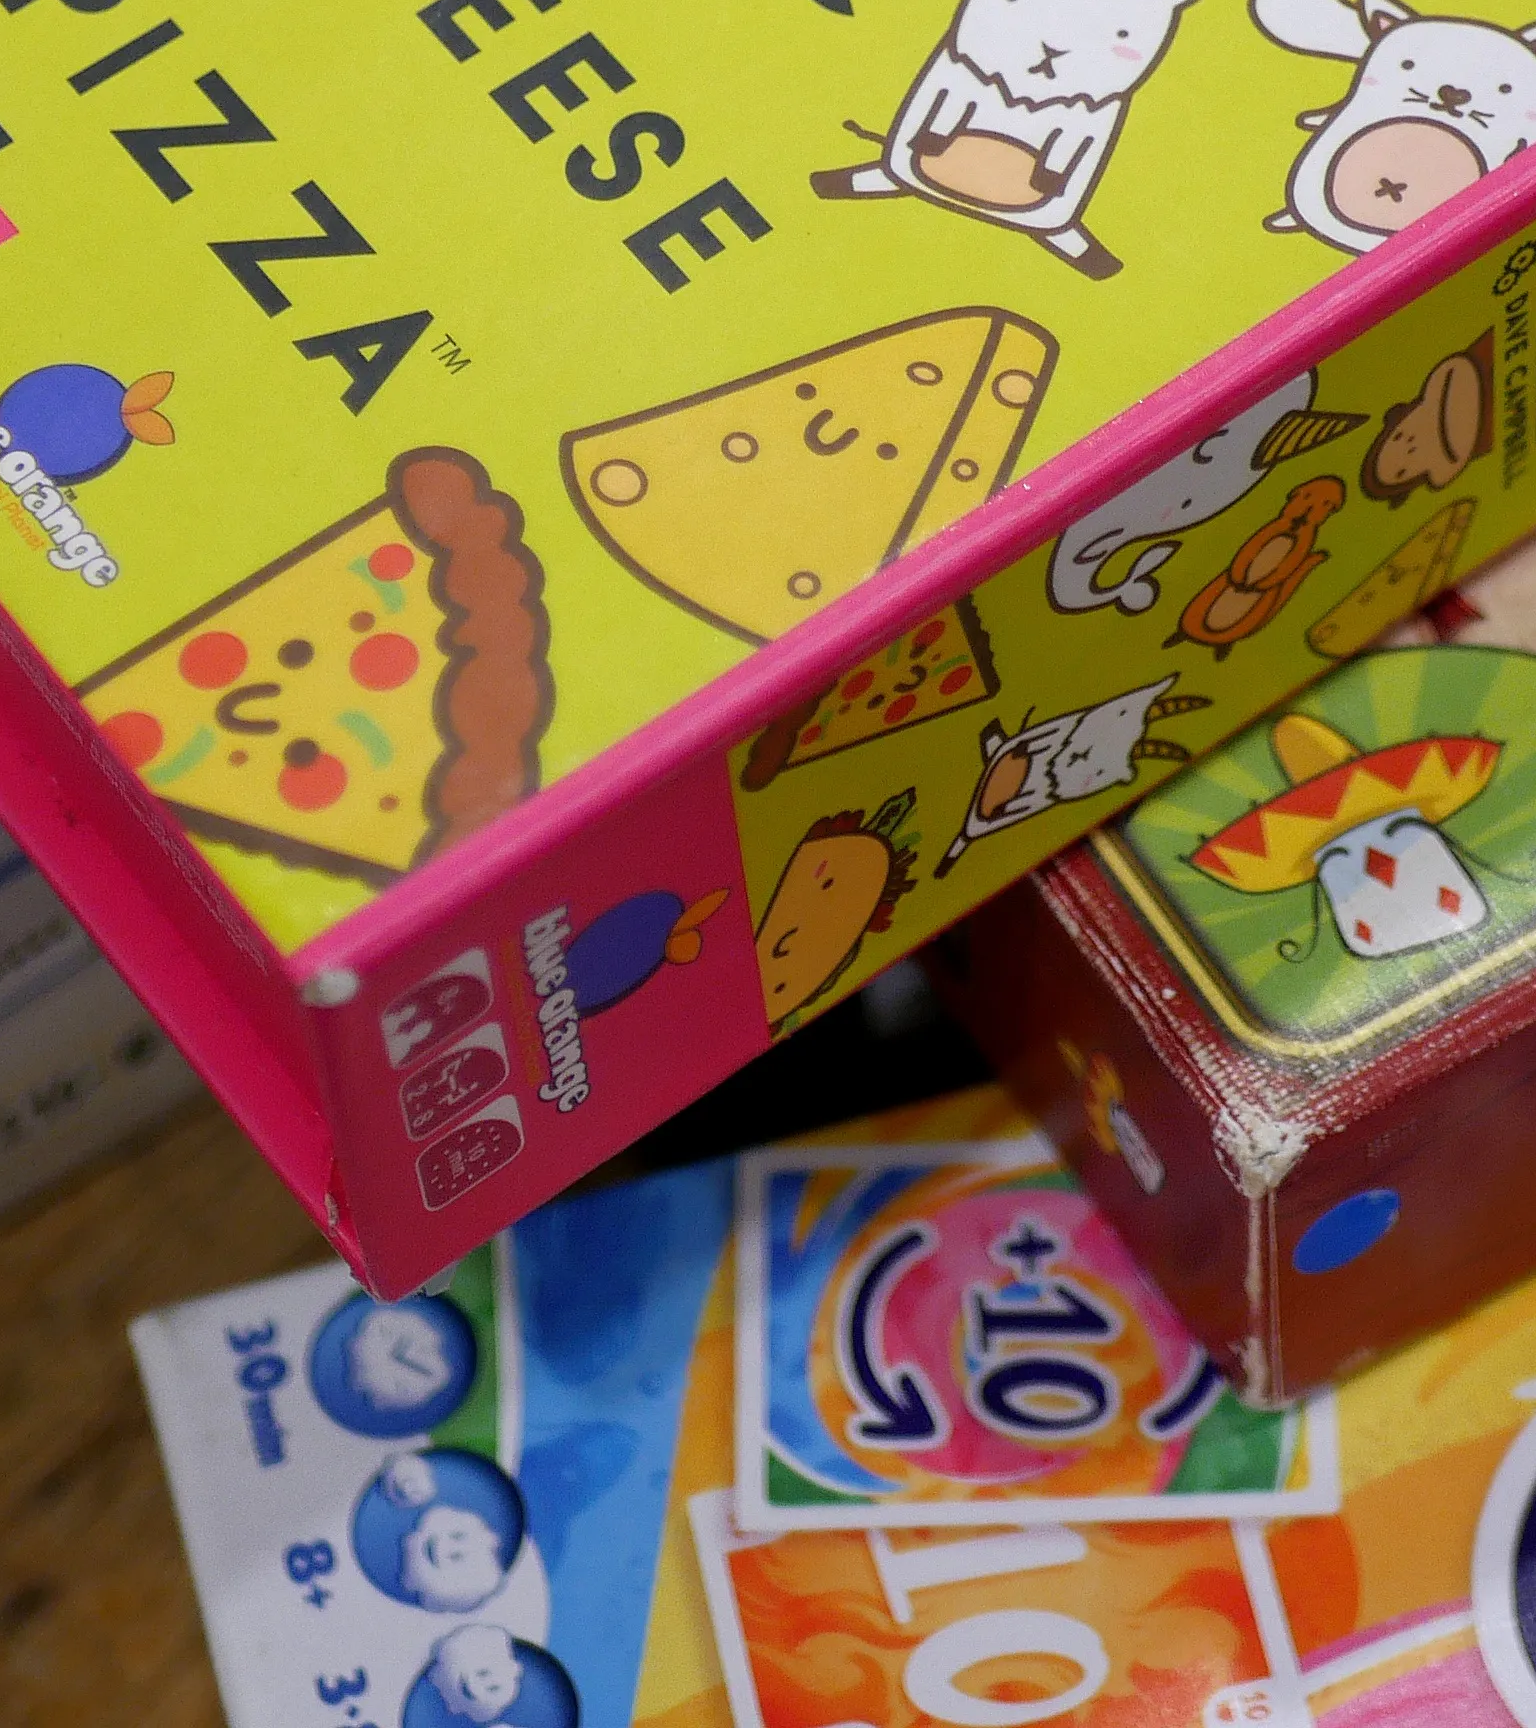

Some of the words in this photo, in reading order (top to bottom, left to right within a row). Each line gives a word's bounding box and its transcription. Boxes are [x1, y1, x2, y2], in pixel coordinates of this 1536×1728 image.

[1504, 290, 1531, 364] DAVE
[1503, 365, 1531, 491] CAMPBELL
[523, 903, 572, 998] blue
[536, 987, 591, 1113] orange
[963, 1221, 1120, 1437] +10
[285, 1538, 336, 1611] 8+
[866, 1527, 1109, 1726] 10
